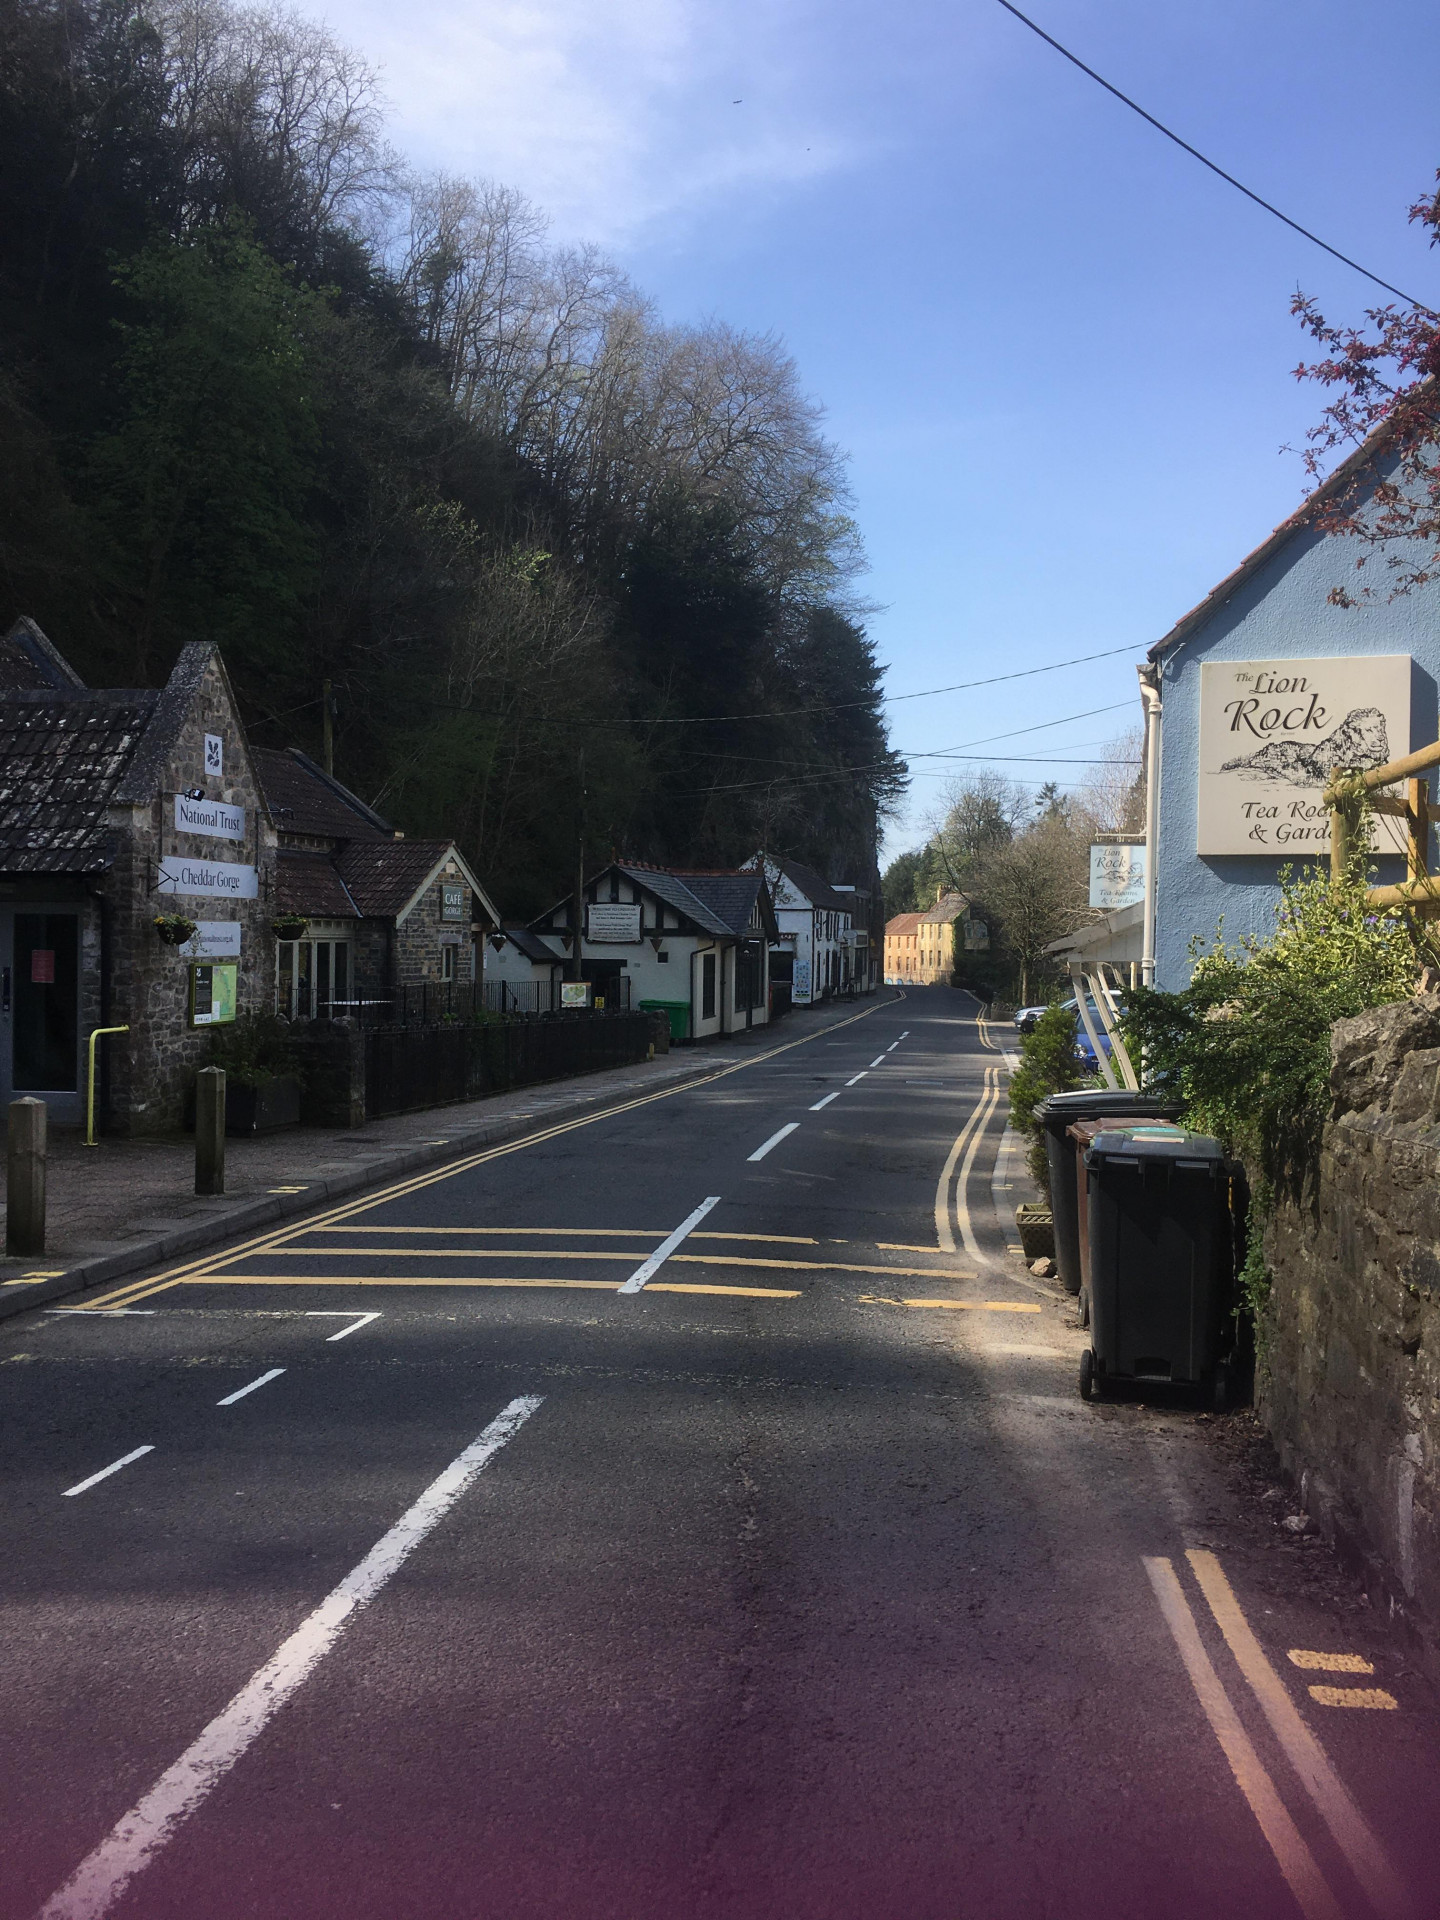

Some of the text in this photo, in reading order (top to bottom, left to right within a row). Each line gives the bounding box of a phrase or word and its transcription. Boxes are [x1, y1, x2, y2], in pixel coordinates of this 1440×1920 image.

[1234, 670, 1313, 694] The Lion
[1223, 693, 1333, 740] Rock
[180, 803, 240, 832] National Trust
[1241, 800, 1334, 822] Tea Roo
[1248, 823, 1269, 844] &
[1094, 855, 1126, 871] Rock
[1103, 848, 1121, 857] Lion
[181, 867, 240, 893] Cheddar Gorge
[445, 891, 462, 905] CAFÉ
[1110, 896, 1136, 904] Garden
[444, 906, 462, 915] GORGE
